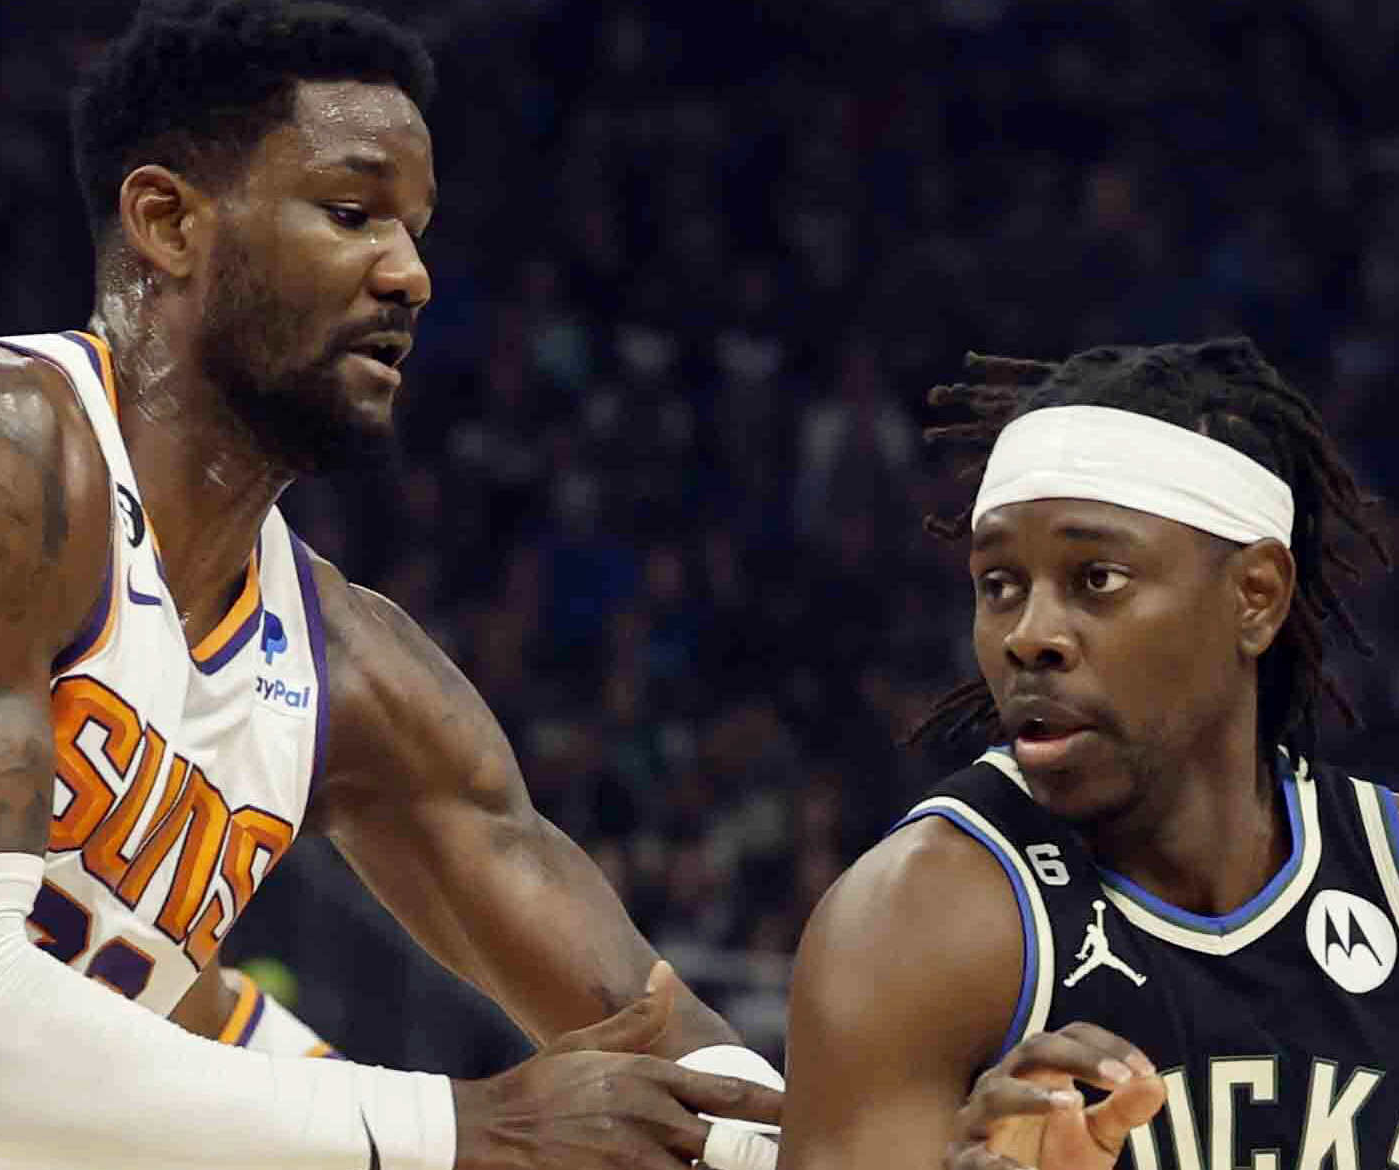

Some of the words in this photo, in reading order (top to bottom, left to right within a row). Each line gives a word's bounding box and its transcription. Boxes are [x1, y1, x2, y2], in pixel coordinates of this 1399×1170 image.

[255, 676, 310, 708] ayPal
[49, 674, 294, 972] SUNS
[1025, 843, 1071, 886] 6
